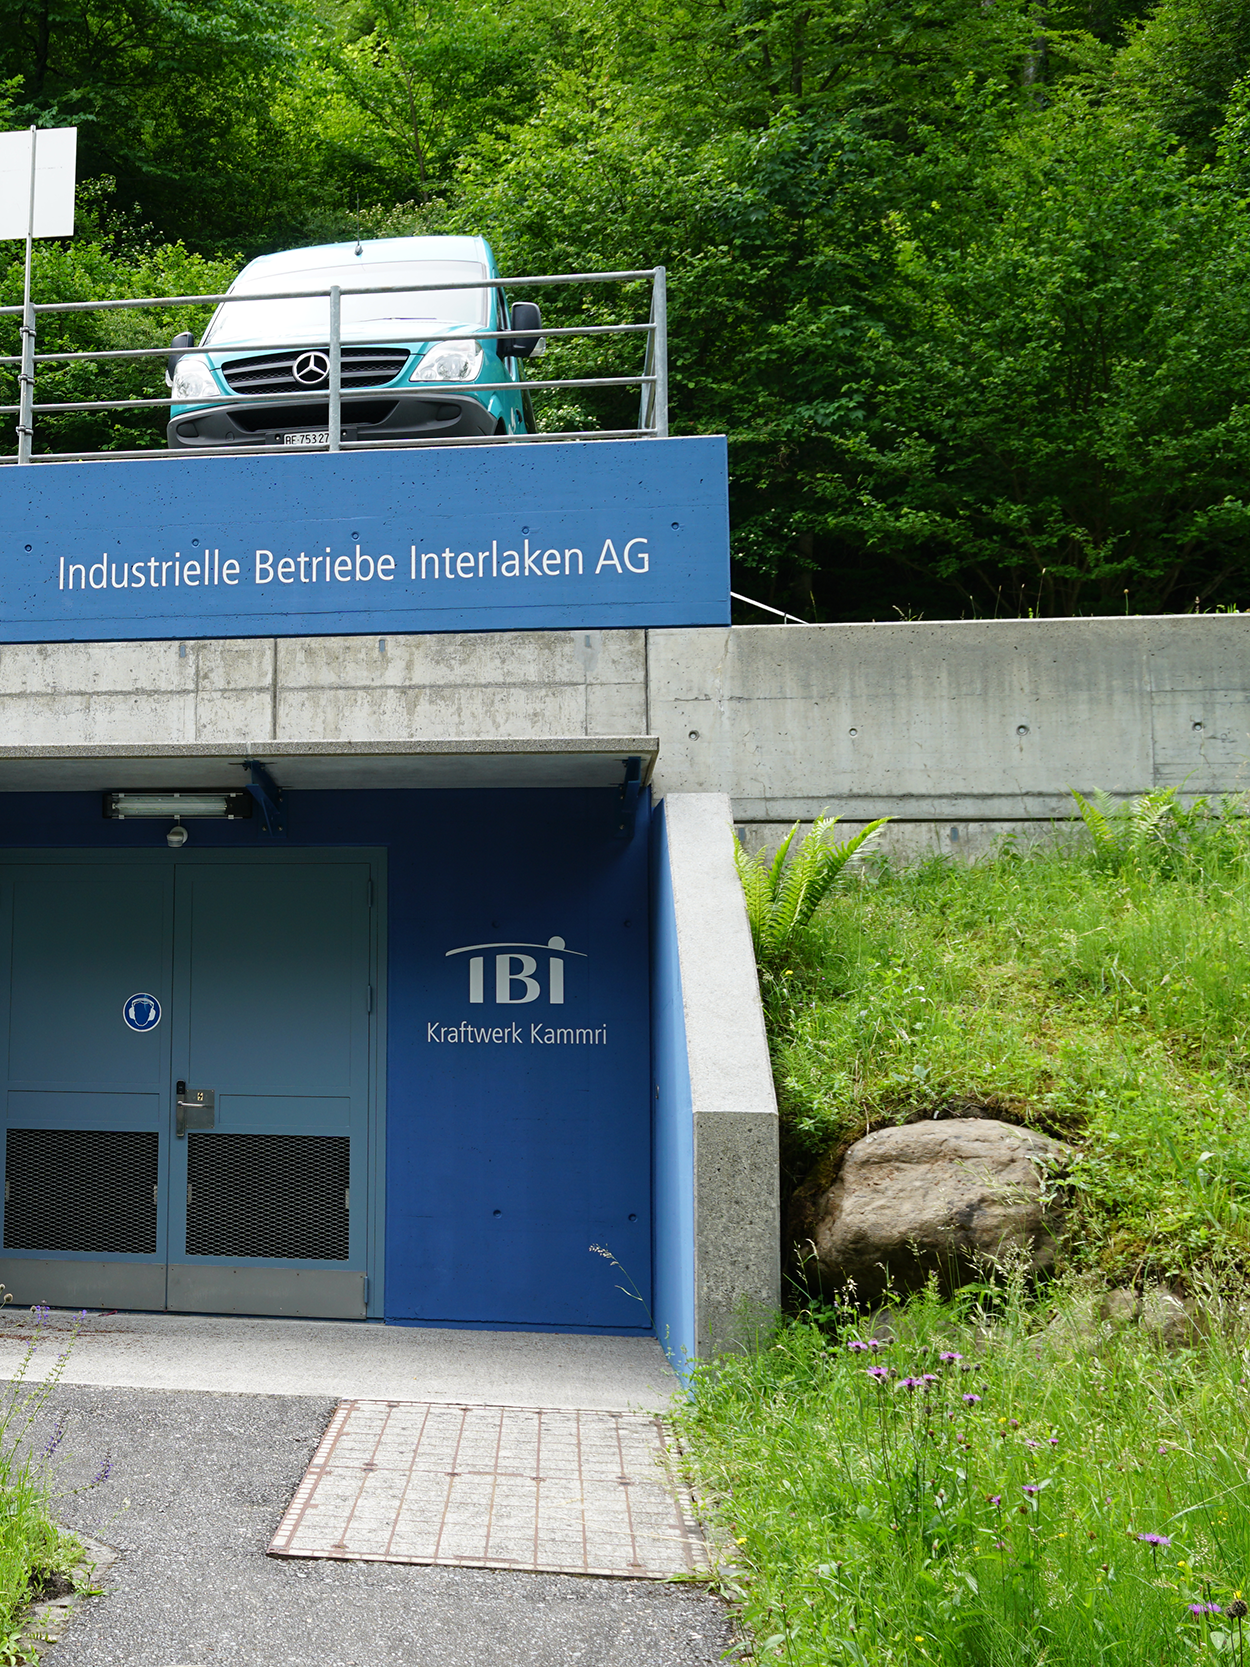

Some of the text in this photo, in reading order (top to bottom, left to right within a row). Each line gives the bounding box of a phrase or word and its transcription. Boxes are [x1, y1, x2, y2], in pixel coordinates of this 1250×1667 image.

[59, 537, 650, 590] Industrielle Betriebe Interlaken AG
[469, 953, 565, 1004] IBI
[427, 1020, 607, 1045] Kraftwerk Kammri
